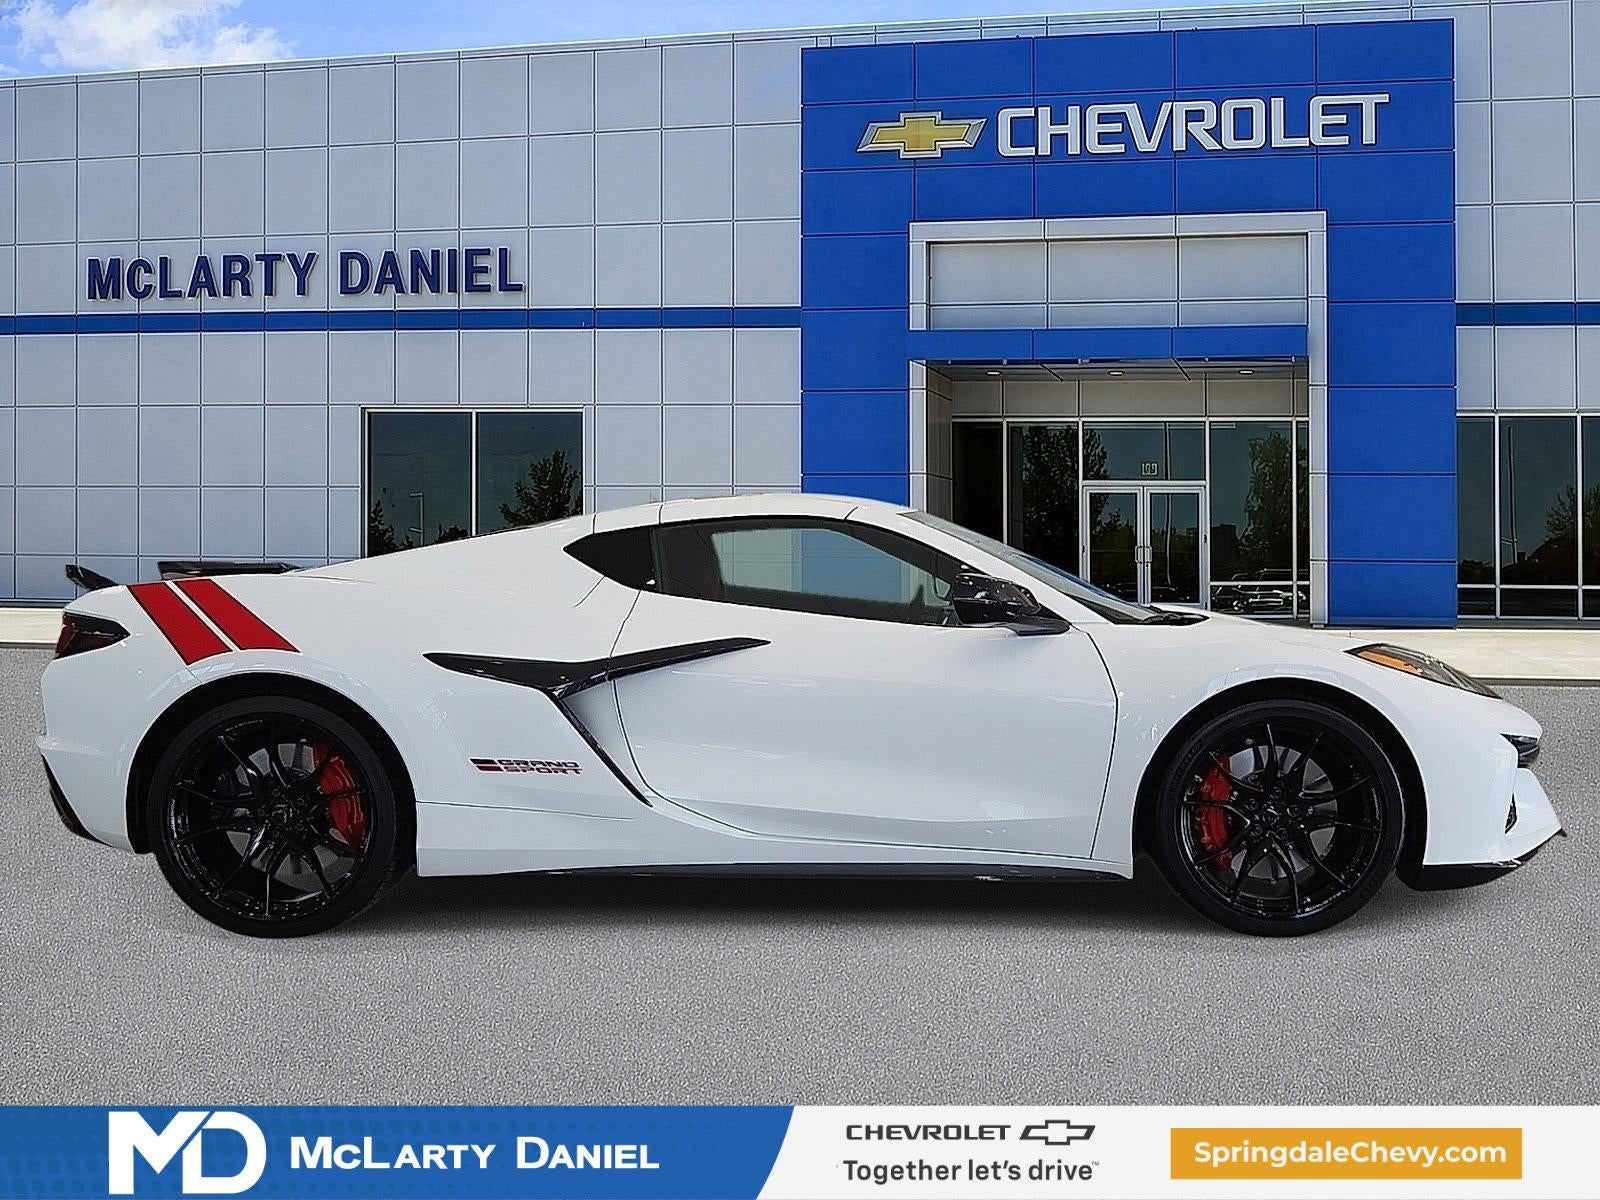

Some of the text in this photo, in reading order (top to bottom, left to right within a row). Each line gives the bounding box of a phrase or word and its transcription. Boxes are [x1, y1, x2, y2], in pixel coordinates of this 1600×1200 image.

[997, 93, 1390, 157] CHEVROLET
[338, 246, 524, 295] DANIEL
[497, 759, 580, 768] GRAND
[503, 766, 583, 775] SPORT
